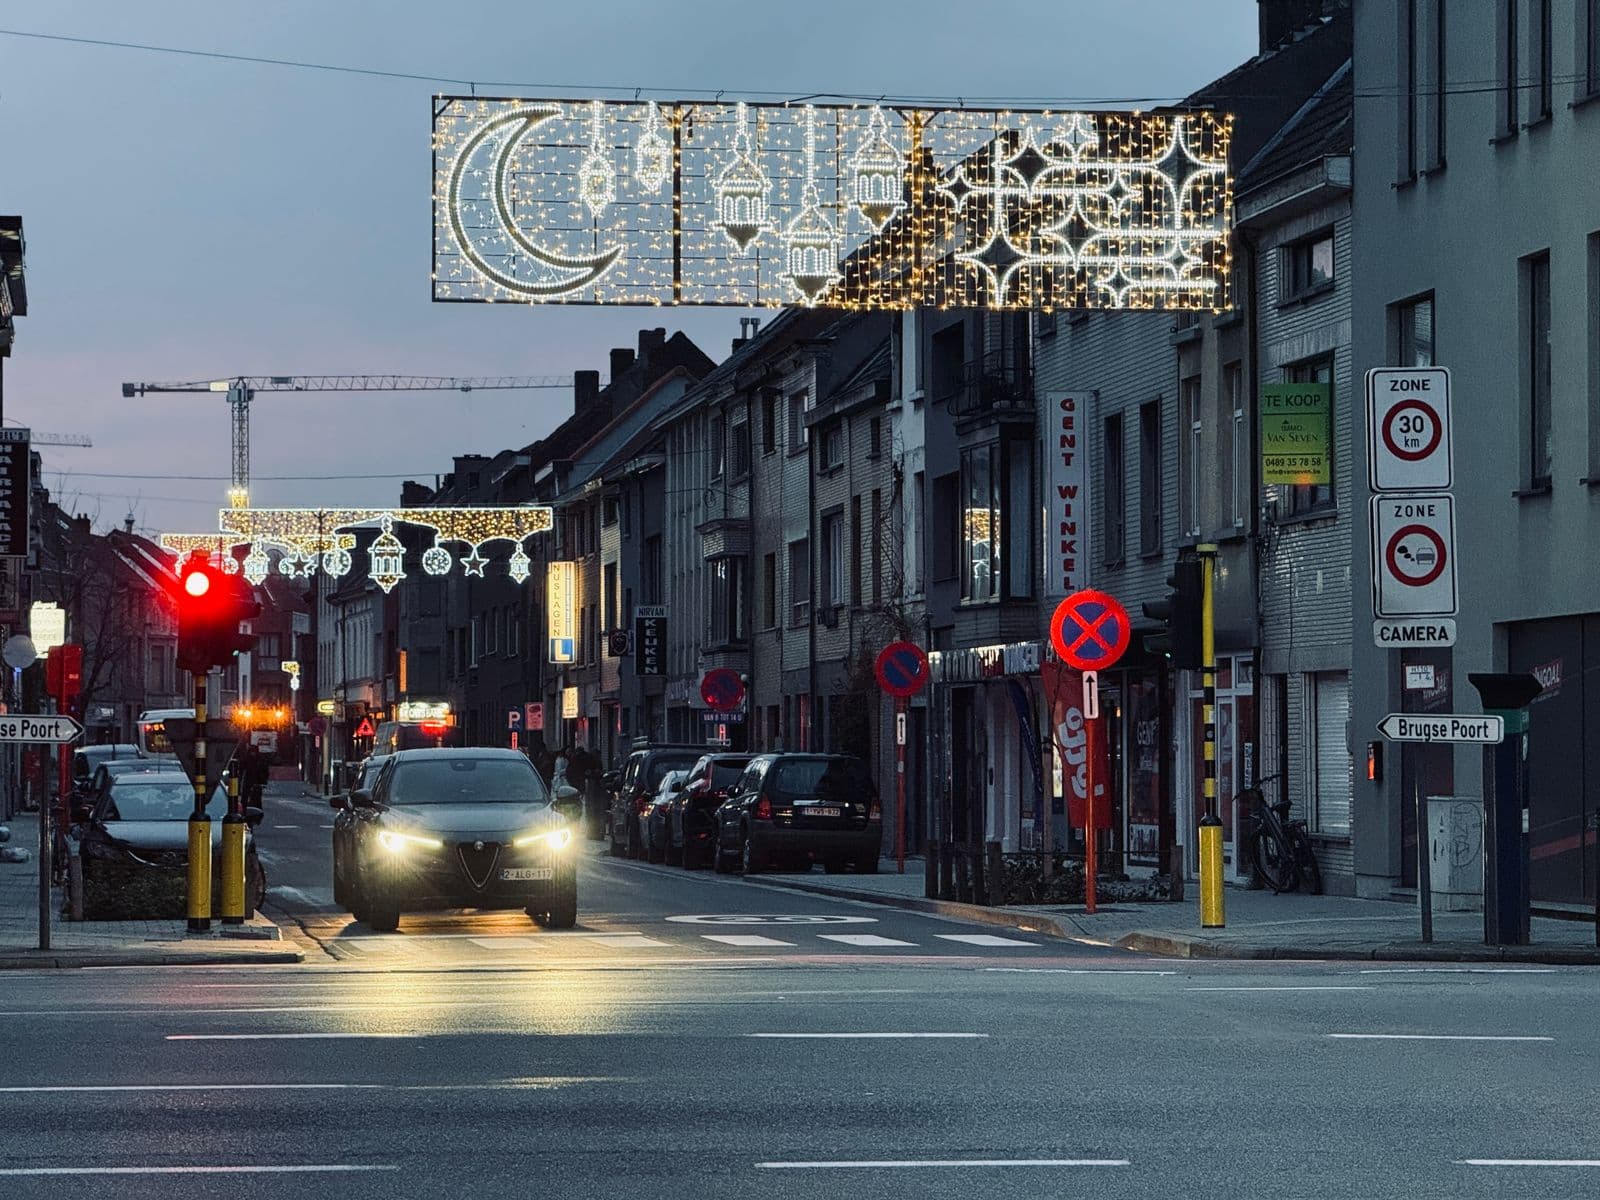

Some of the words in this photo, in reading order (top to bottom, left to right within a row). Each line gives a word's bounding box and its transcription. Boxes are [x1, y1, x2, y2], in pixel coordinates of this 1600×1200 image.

[1390, 379, 1431, 391] ZONE
[1264, 394, 1281, 407] TE
[1285, 394, 1321, 406] KOOP
[1060, 398, 1076, 466] GENT
[1399, 415, 1424, 434] 30
[1404, 436, 1420, 448] km
[1265, 457, 1284, 466] 0489
[1287, 457, 1297, 466] 35
[1299, 457, 1309, 466] 78
[1311, 457, 1321, 465] 58
[1394, 505, 1436, 517] ZONE
[1057, 485, 1078, 591] WINKEL
[638, 607, 665, 617] NIRVAN
[1380, 626, 1449, 641] CAMERA
[645, 618, 658, 674] KEUKEN
[21, 719, 60, 737] Poort
[508, 711, 521, 729] P
[1398, 718, 1447, 741] Brugse
[1451, 719, 1489, 738] Poort
